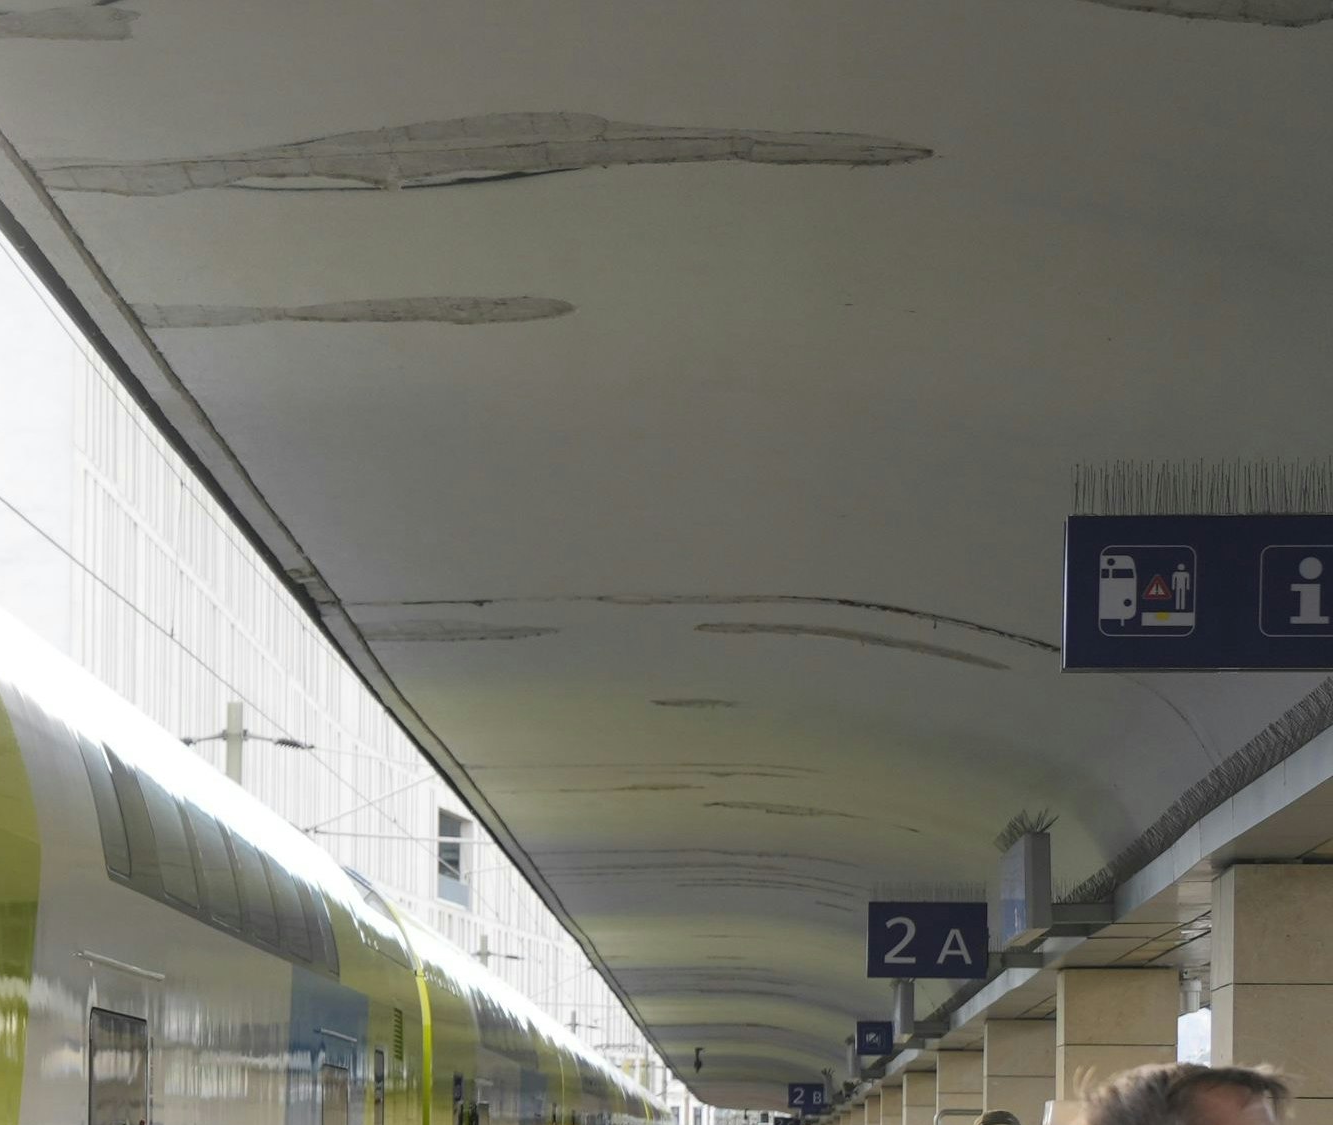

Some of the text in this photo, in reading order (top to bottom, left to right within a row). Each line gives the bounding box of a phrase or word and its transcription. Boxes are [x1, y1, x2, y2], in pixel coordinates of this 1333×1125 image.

[883, 916, 972, 965] 2 A
[793, 1087, 822, 1105] 2 B
